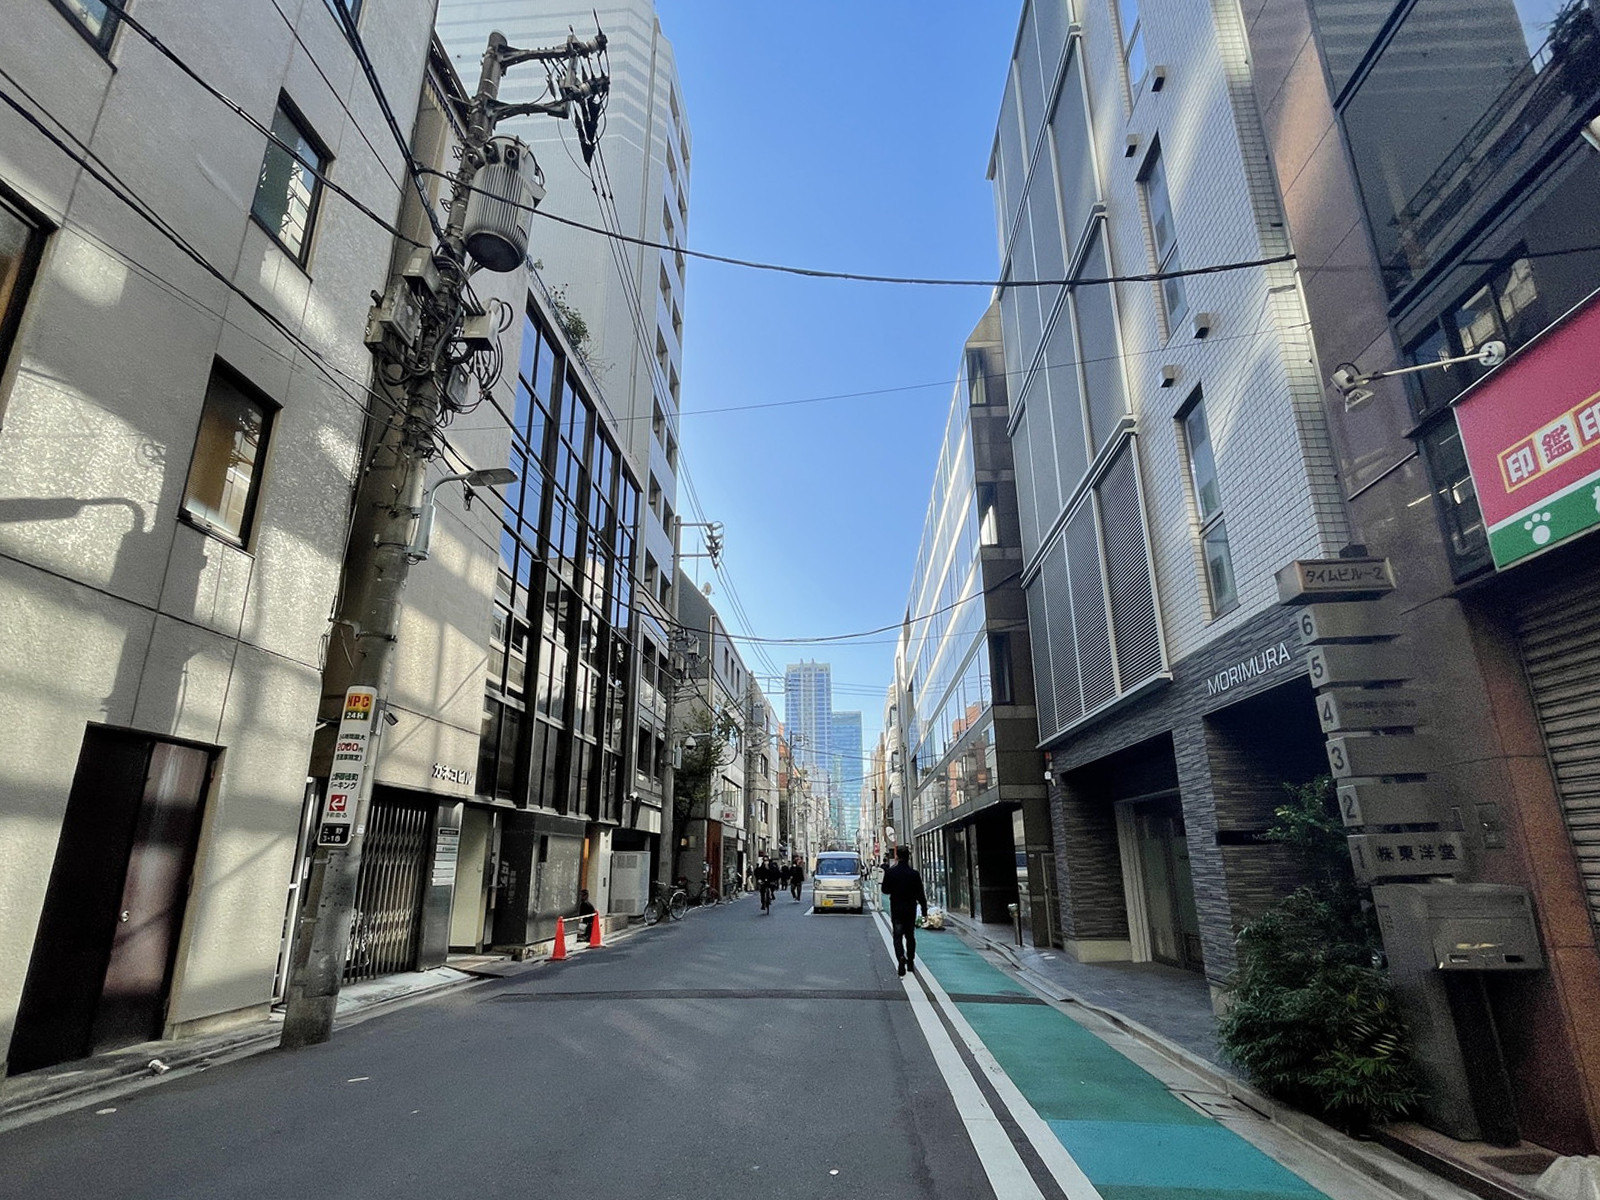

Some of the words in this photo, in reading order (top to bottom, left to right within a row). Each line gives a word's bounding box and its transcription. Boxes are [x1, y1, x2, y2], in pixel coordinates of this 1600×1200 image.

[1301, 614, 1313, 636] 6
[1207, 642, 1291, 696] MORIMURA
[1311, 655, 1323, 679] 5
[1323, 701, 1334, 723] 4
[1332, 746, 1345, 770] 3
[1343, 794, 1357, 819] 2
[1355, 844, 1366, 869] 1
